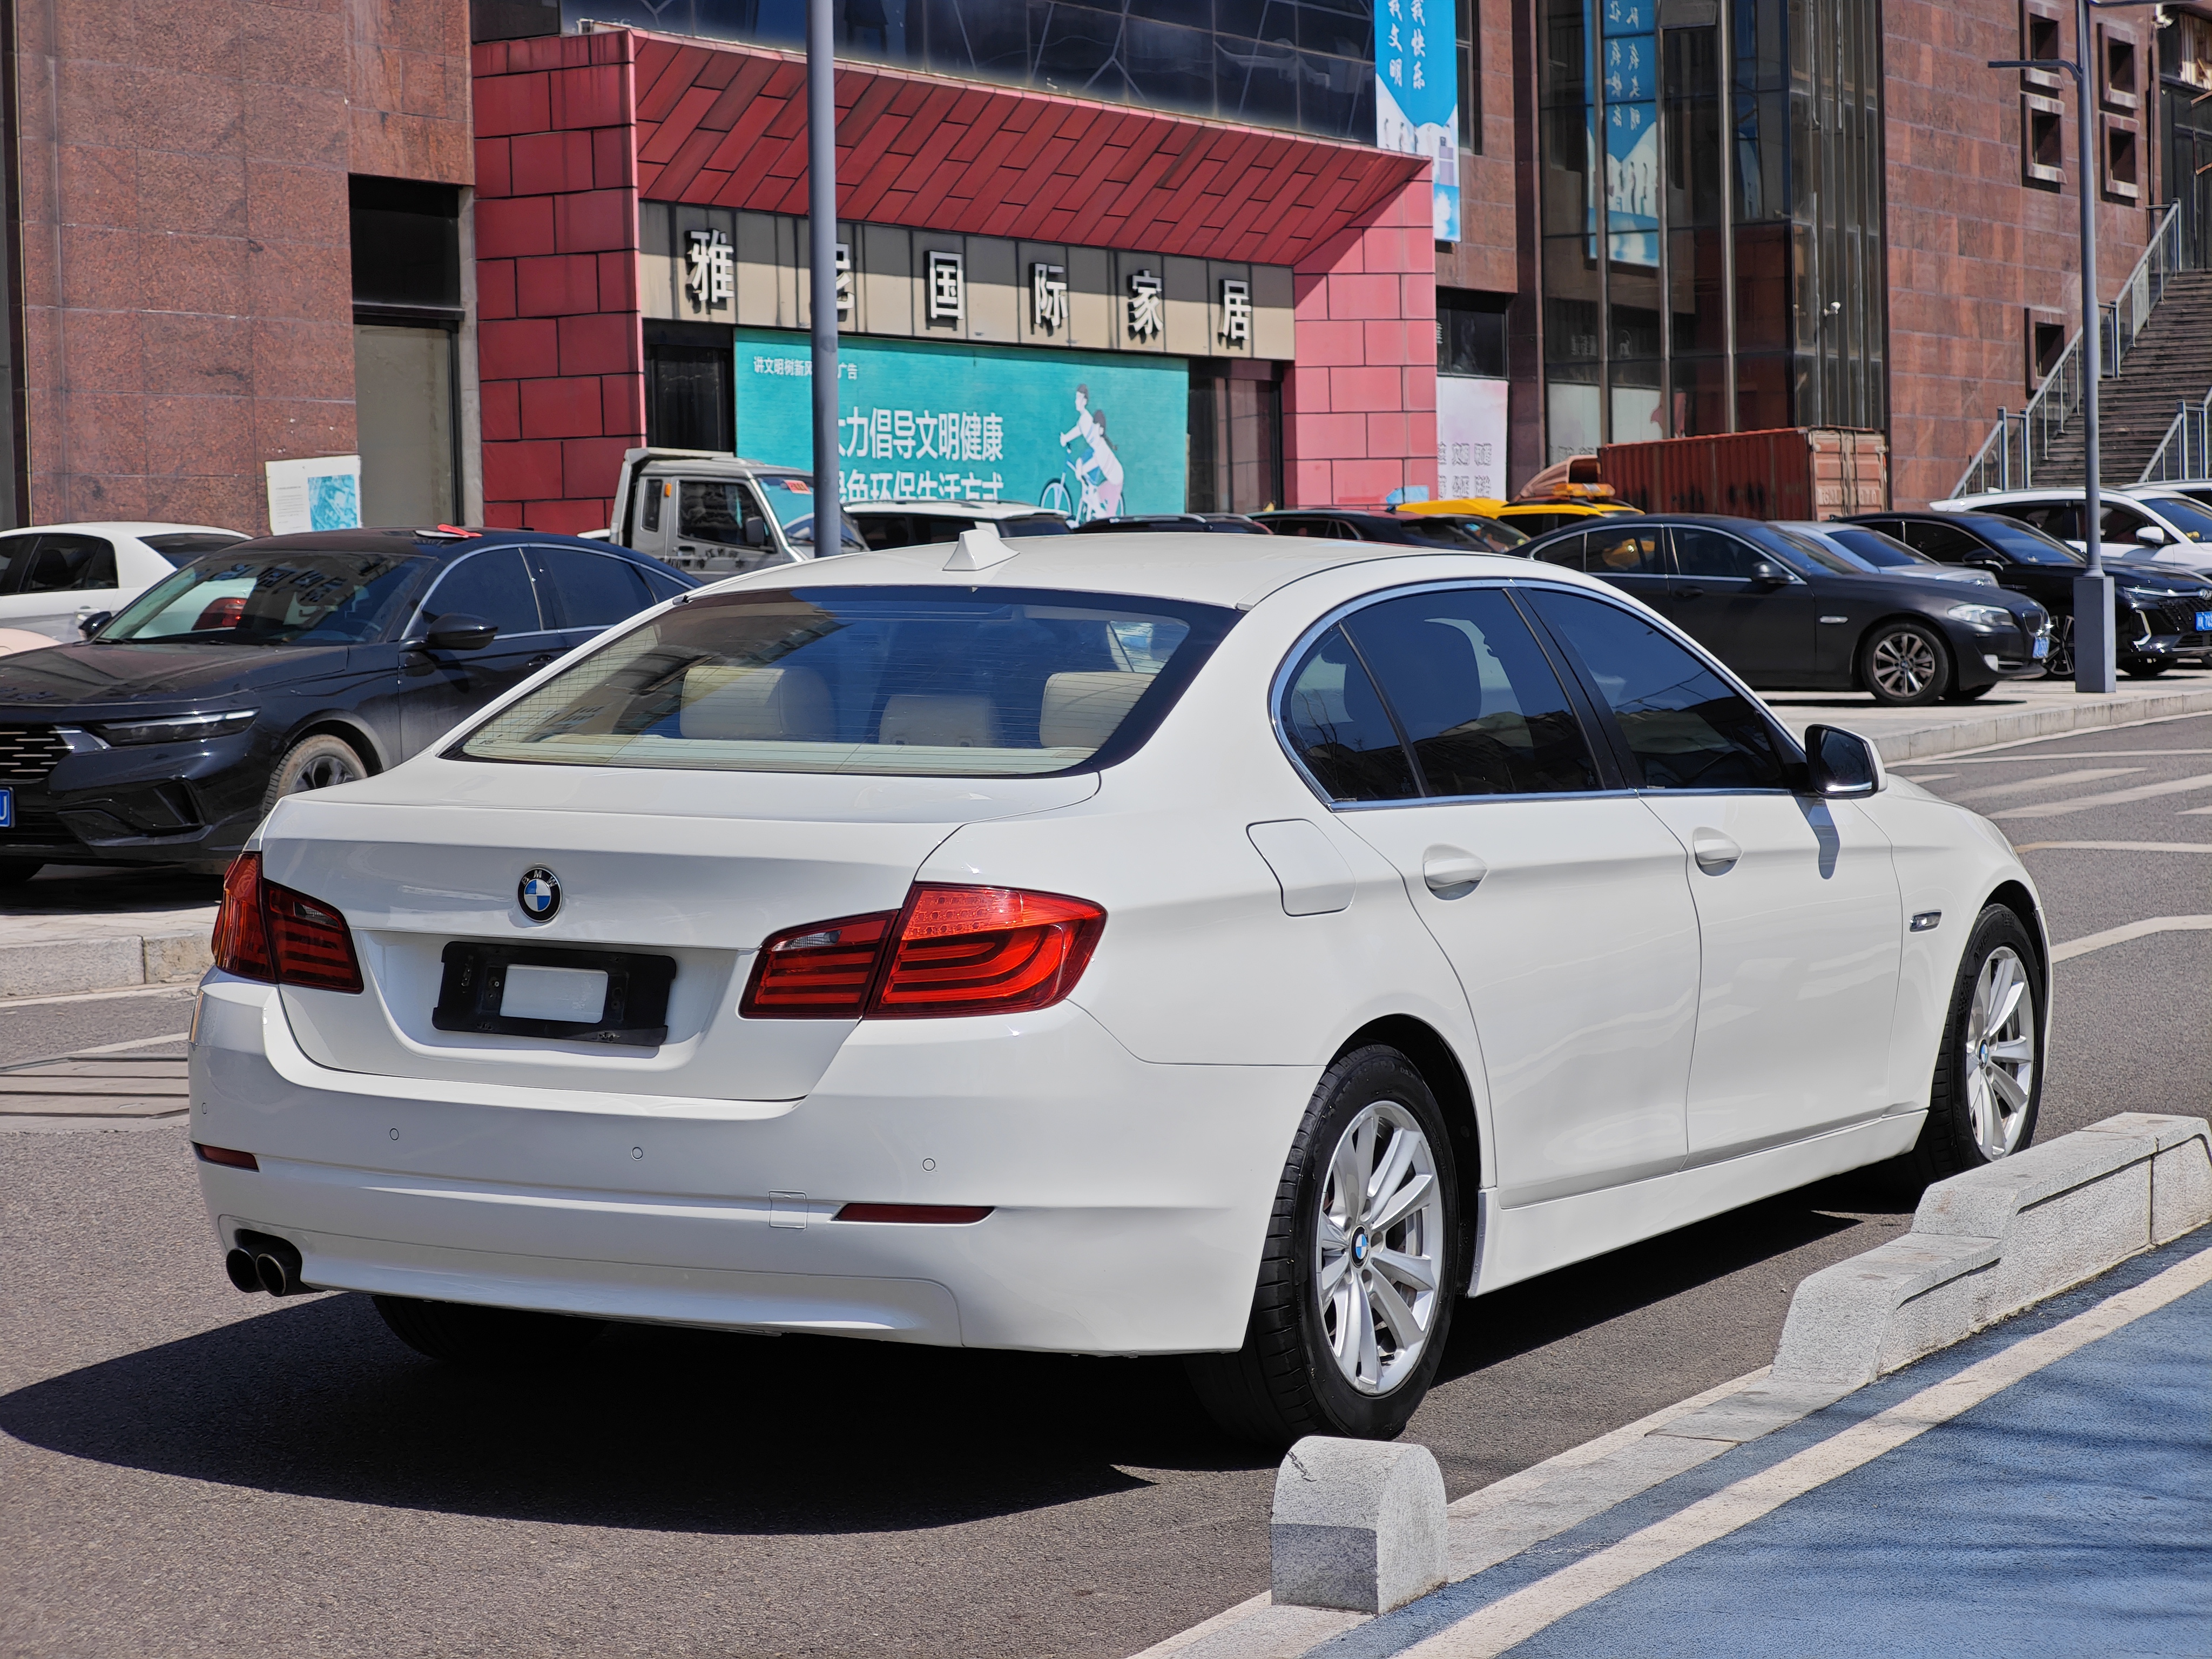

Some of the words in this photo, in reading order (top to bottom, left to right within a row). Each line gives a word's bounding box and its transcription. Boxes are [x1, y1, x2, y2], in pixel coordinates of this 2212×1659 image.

[838, 469, 1003, 501] 色环保生活方式
[521, 870, 558, 887] BMW
